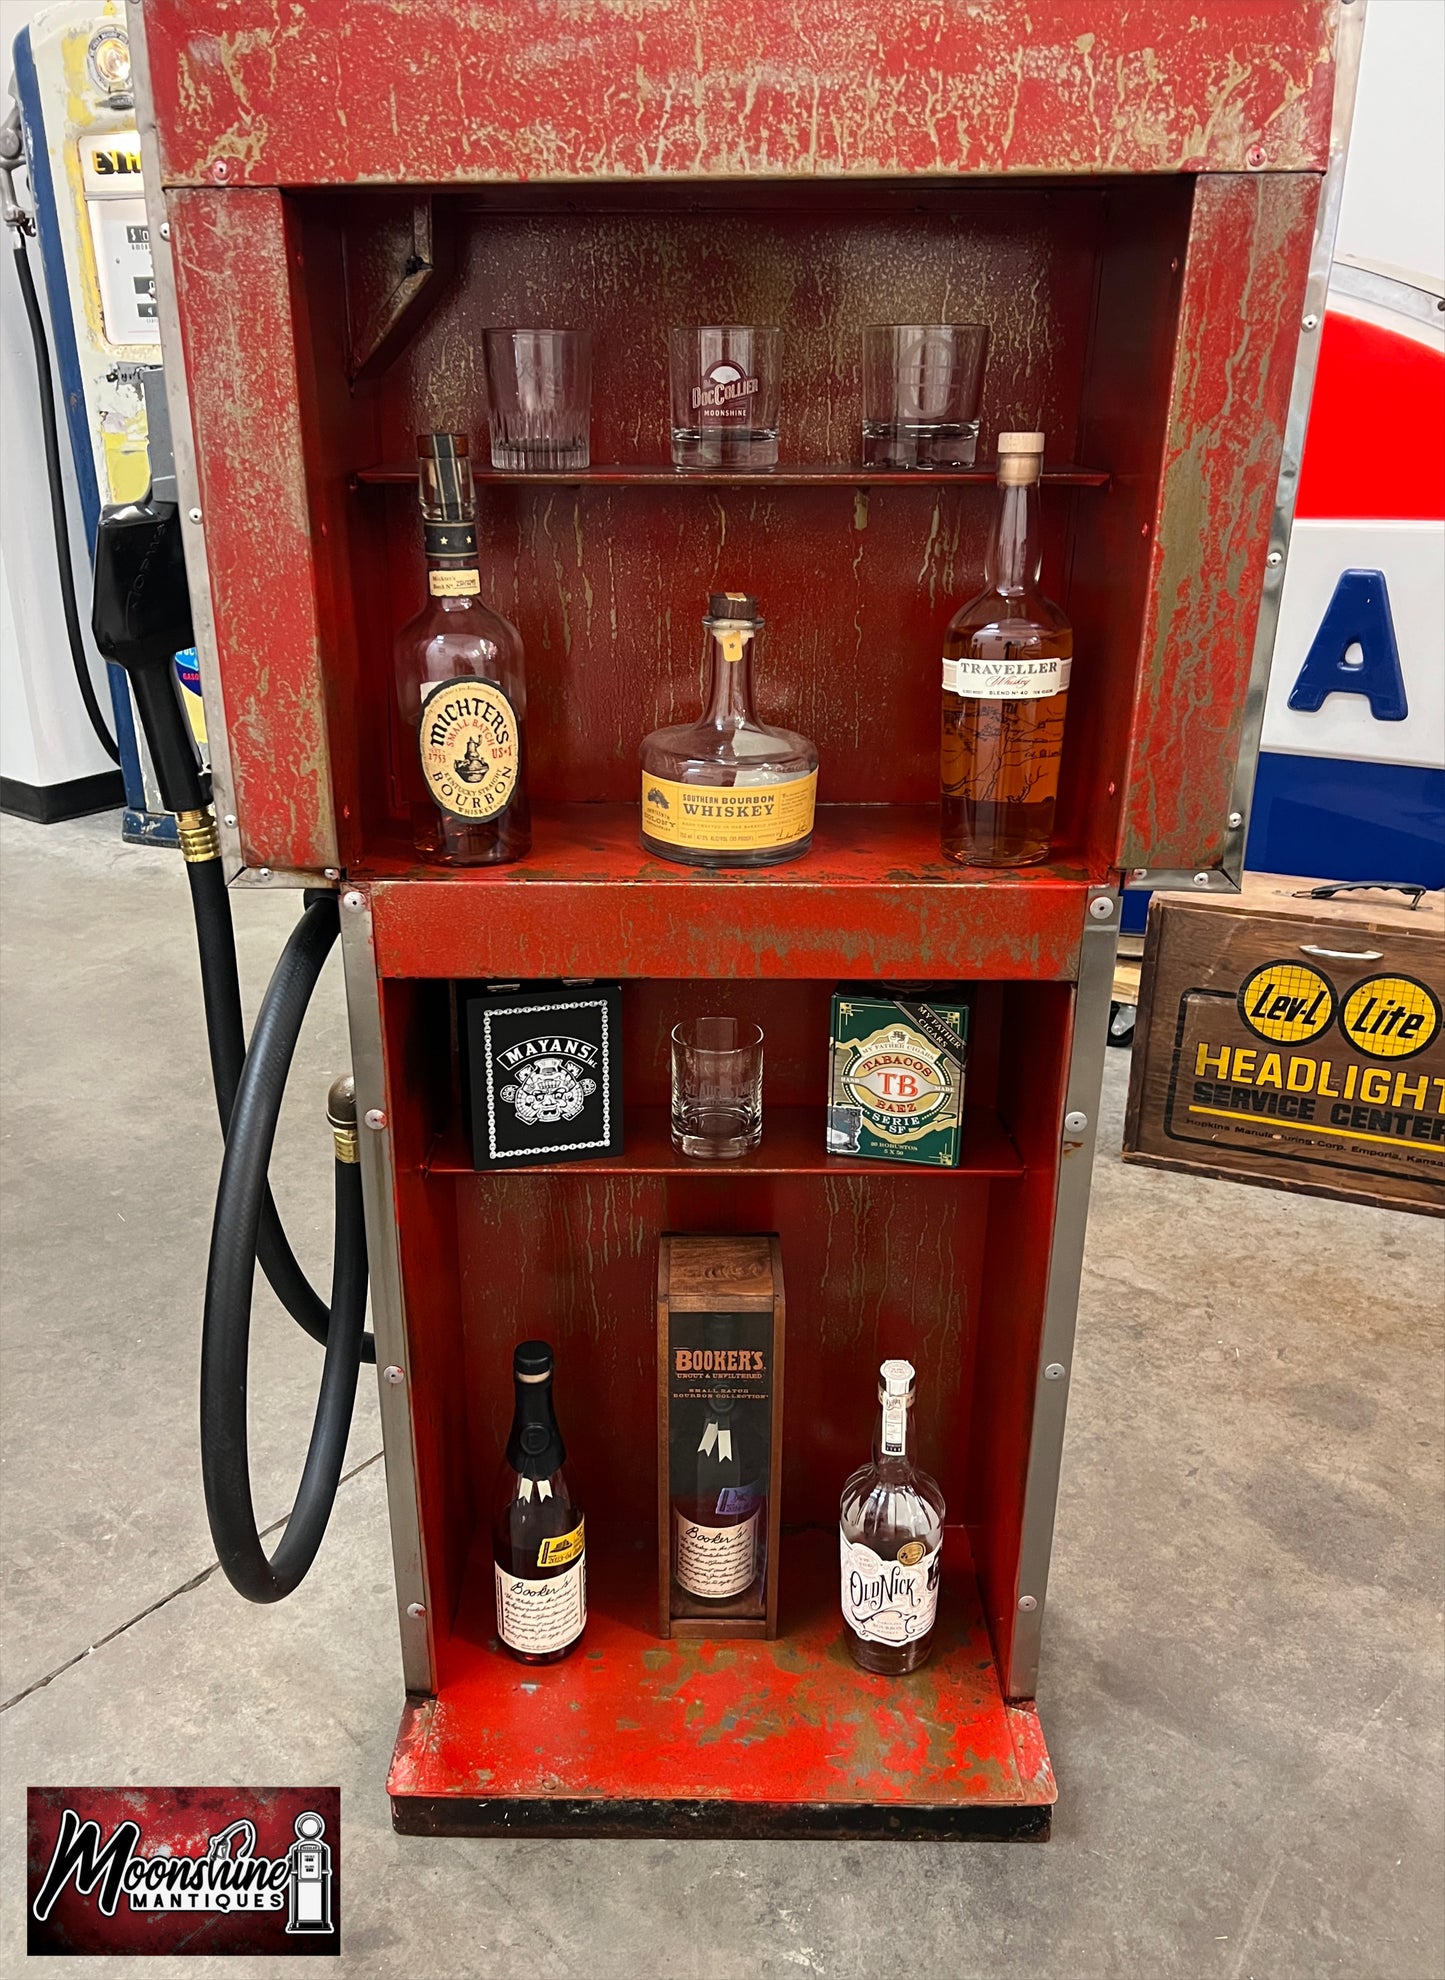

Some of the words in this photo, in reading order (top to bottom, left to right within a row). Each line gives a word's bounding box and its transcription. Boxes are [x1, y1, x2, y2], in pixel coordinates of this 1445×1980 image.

[1287, 568, 1409, 722] A
[960, 661, 1058, 675] TRAVELLER
[446, 719, 470, 748] SMALL
[472, 718, 496, 747] BATCH
[428, 753, 446, 764] 1753
[432, 766, 513, 808] BOURBON
[443, 772, 476, 797] KENTUCKY
[477, 769, 502, 795] STRAIGHT
[458, 805, 494, 815] WHISKEY
[682, 794, 719, 804] SOUTHERN
[721, 794, 775, 804] BOURBON
[683, 803, 775, 818] WHISKEY
[918, 1006, 932, 1019] MY
[931, 1019, 961, 1049] FATHER
[1351, 997, 1425, 1039] Lite
[918, 1018, 949, 1048] CIGARS
[505, 1039, 592, 1065] MAYANS
[875, 1041, 906, 1050] FATHER
[862, 1054, 933, 1077] TABACOS
[876, 1071, 919, 1098] TB
[875, 1099, 917, 1113] BAEZ
[1193, 1081, 1316, 1121] SERVICE
[872, 1112, 920, 1126] SERIE
[889, 1124, 906, 1134] SF
[1185, 1117, 1231, 1132] Hopkins
[1234, 1125, 1313, 1147] Manufaturing
[1316, 1139, 1347, 1152] Corp.
[675, 1350, 764, 1371] BOOKER'S
[686, 1526, 748, 1544] Booker's
[510, 1574, 573, 1597] Booker's
